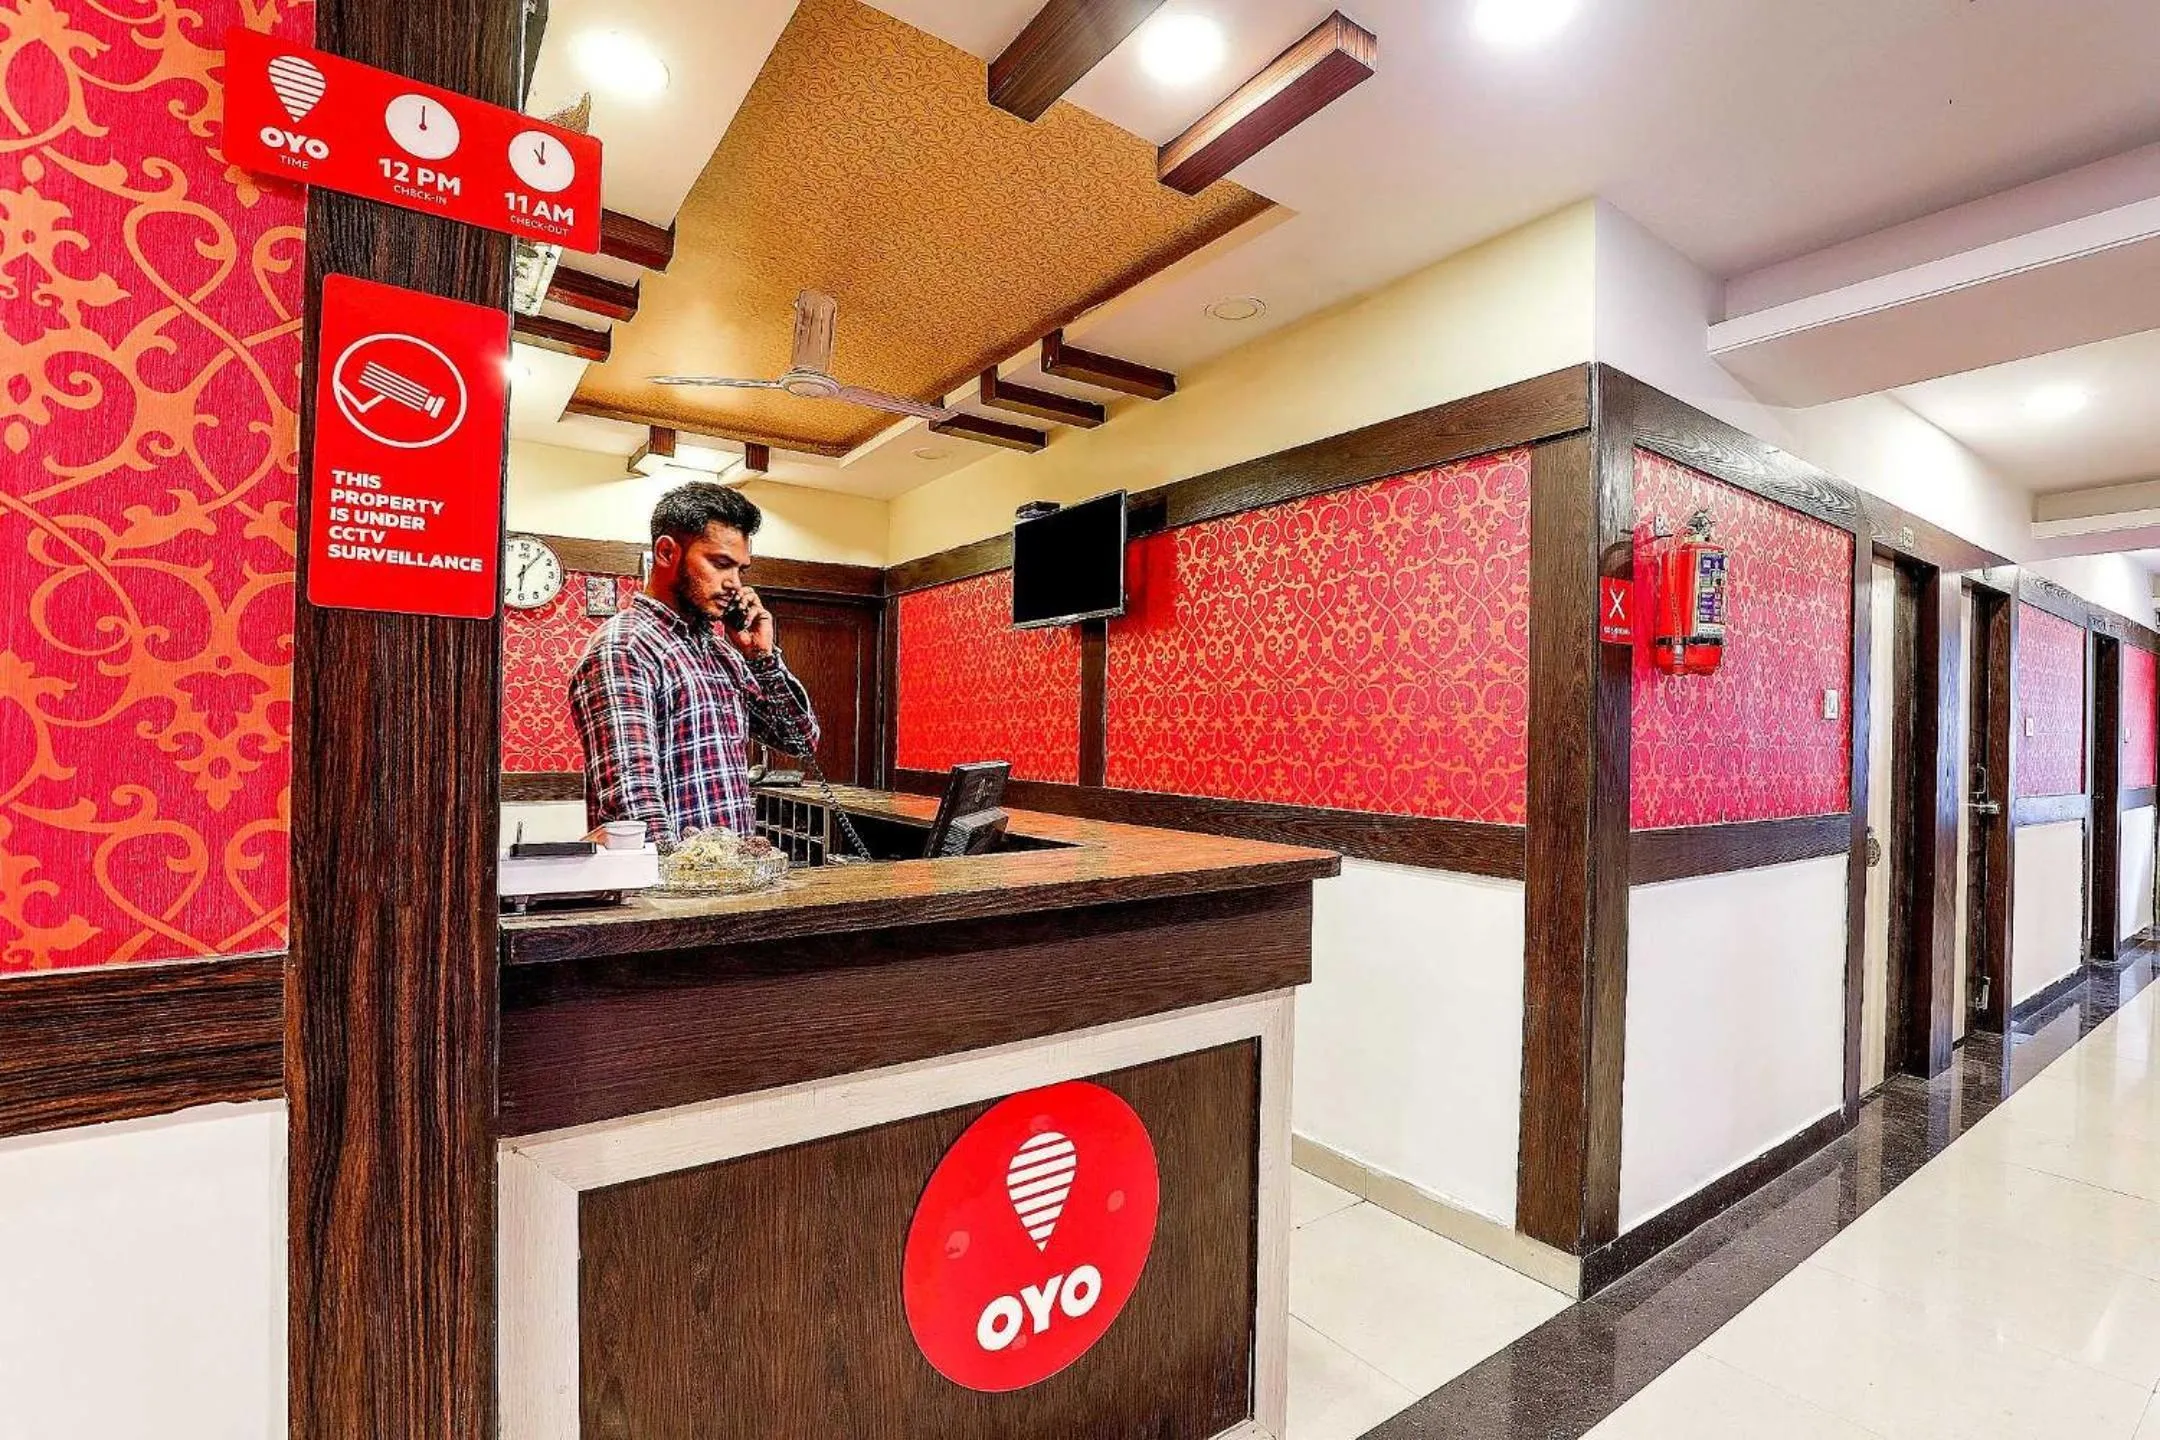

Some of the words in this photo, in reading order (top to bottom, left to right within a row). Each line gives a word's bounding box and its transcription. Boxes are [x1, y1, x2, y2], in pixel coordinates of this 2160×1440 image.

[260, 126, 329, 160] OYO
[280, 154, 309, 170] TIME
[378, 158, 410, 183] 12
[417, 170, 462, 197] PM
[393, 184, 447, 205] CHECK-IN
[504, 192, 528, 214] 11
[534, 199, 574, 226] AM
[510, 215, 570, 237] CHECK-OUT
[331, 469, 382, 489] THIS
[330, 488, 444, 515] PROPERTY
[329, 507, 349, 522] IS
[354, 510, 425, 531] UNDER
[328, 525, 386, 544] CCTV
[328, 544, 483, 573] SURVEILLANCE
[521, 543, 531, 552] 12
[976, 1264, 1102, 1352] OYO
